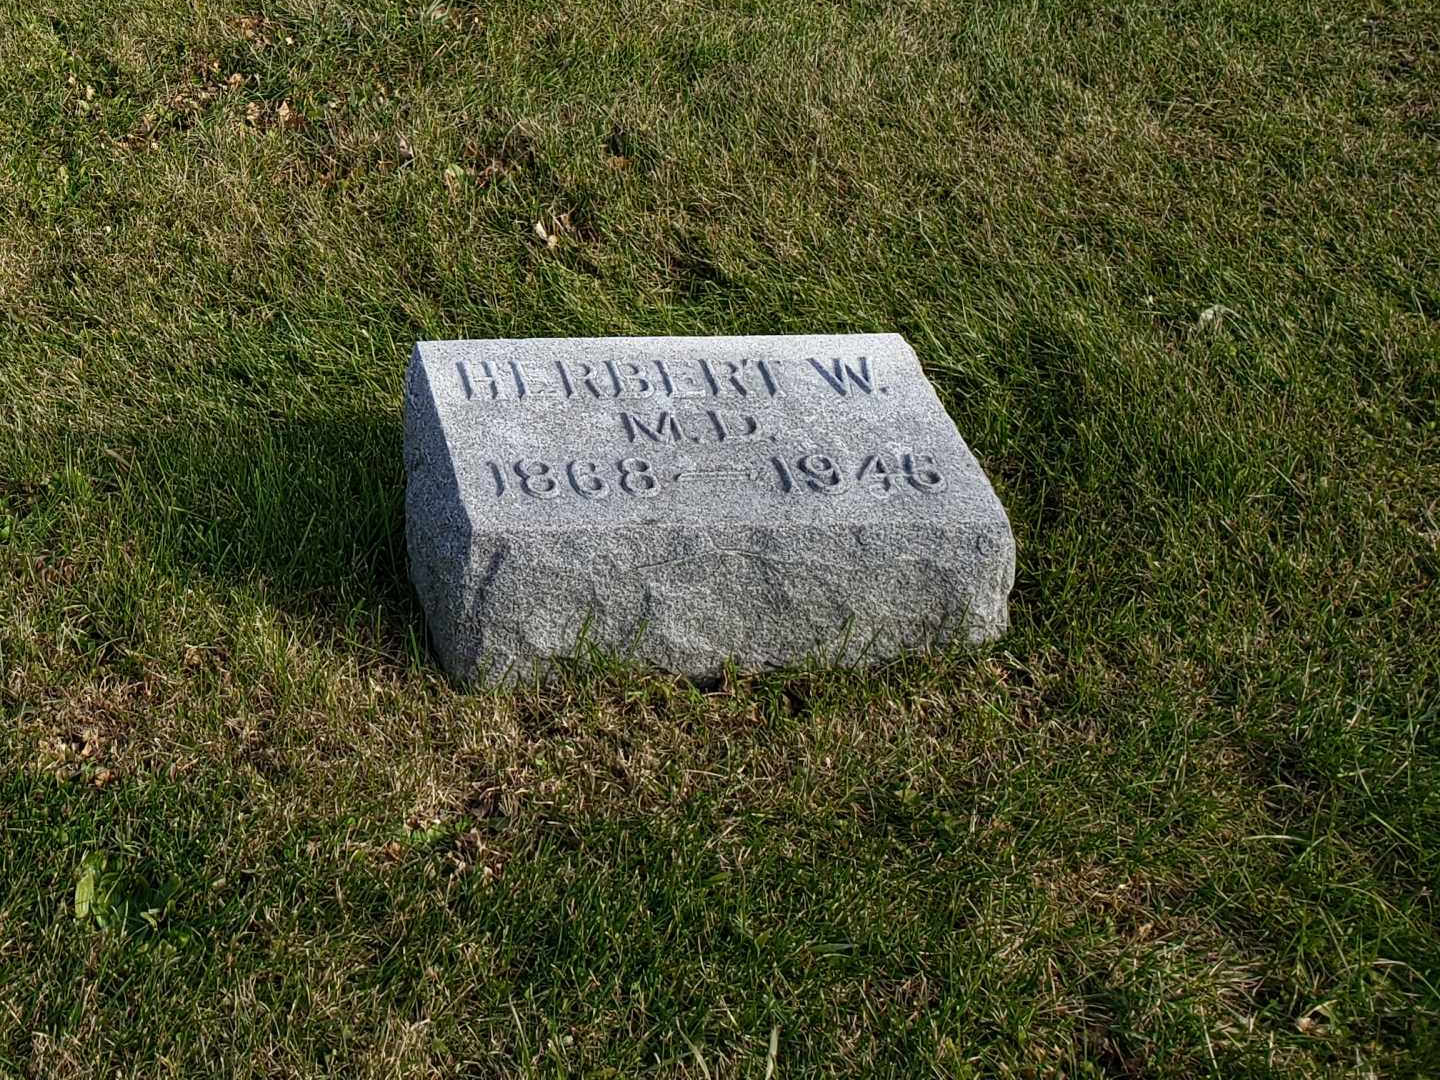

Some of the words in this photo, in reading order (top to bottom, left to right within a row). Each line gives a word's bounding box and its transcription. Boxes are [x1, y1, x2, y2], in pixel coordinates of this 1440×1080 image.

[456, 358, 789, 401] HERBERT
[805, 356, 888, 398] W.
[619, 409, 777, 443] M.D.
